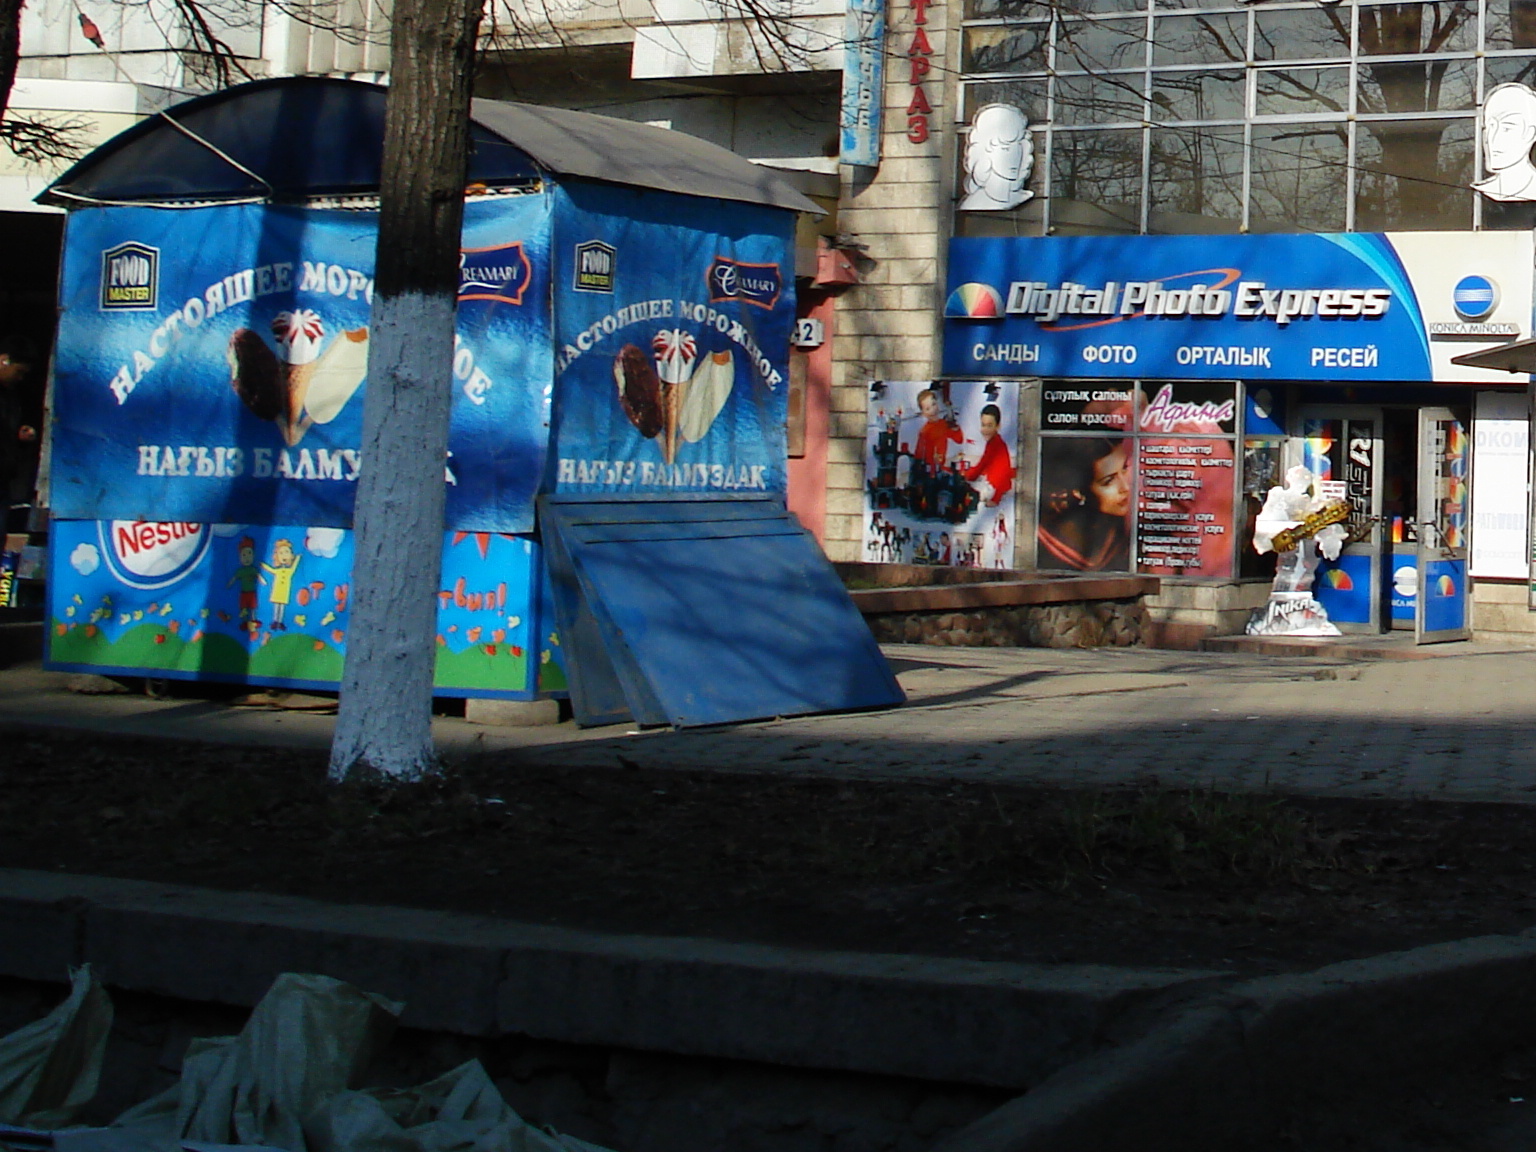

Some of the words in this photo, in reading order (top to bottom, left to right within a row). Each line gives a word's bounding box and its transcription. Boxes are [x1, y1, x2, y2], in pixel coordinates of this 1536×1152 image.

[110, 254, 149, 286] FOOD
[581, 250, 611, 275] FOOD
[108, 287, 149, 301] MASTER
[1004, 279, 1118, 322] Digital
[1120, 280, 1232, 318] Photo
[1234, 279, 1393, 323] Express
[110, 261, 293, 406] НАСТОЯЩЕЕ
[1429, 322, 1467, 334] KONICA
[1469, 322, 1514, 334] MINOLTA
[972, 342, 1040, 364] САНДЫ
[1082, 343, 1137, 365] ФОТО
[1176, 344, 1271, 370] ОРТАЛЫҚ
[1311, 343, 1379, 368] РЕСЕЙ
[1092, 390, 1133, 402] салоны
[1141, 384, 1235, 432] Афина
[1047, 413, 1079, 424] салон
[1081, 413, 1127, 426] красоты
